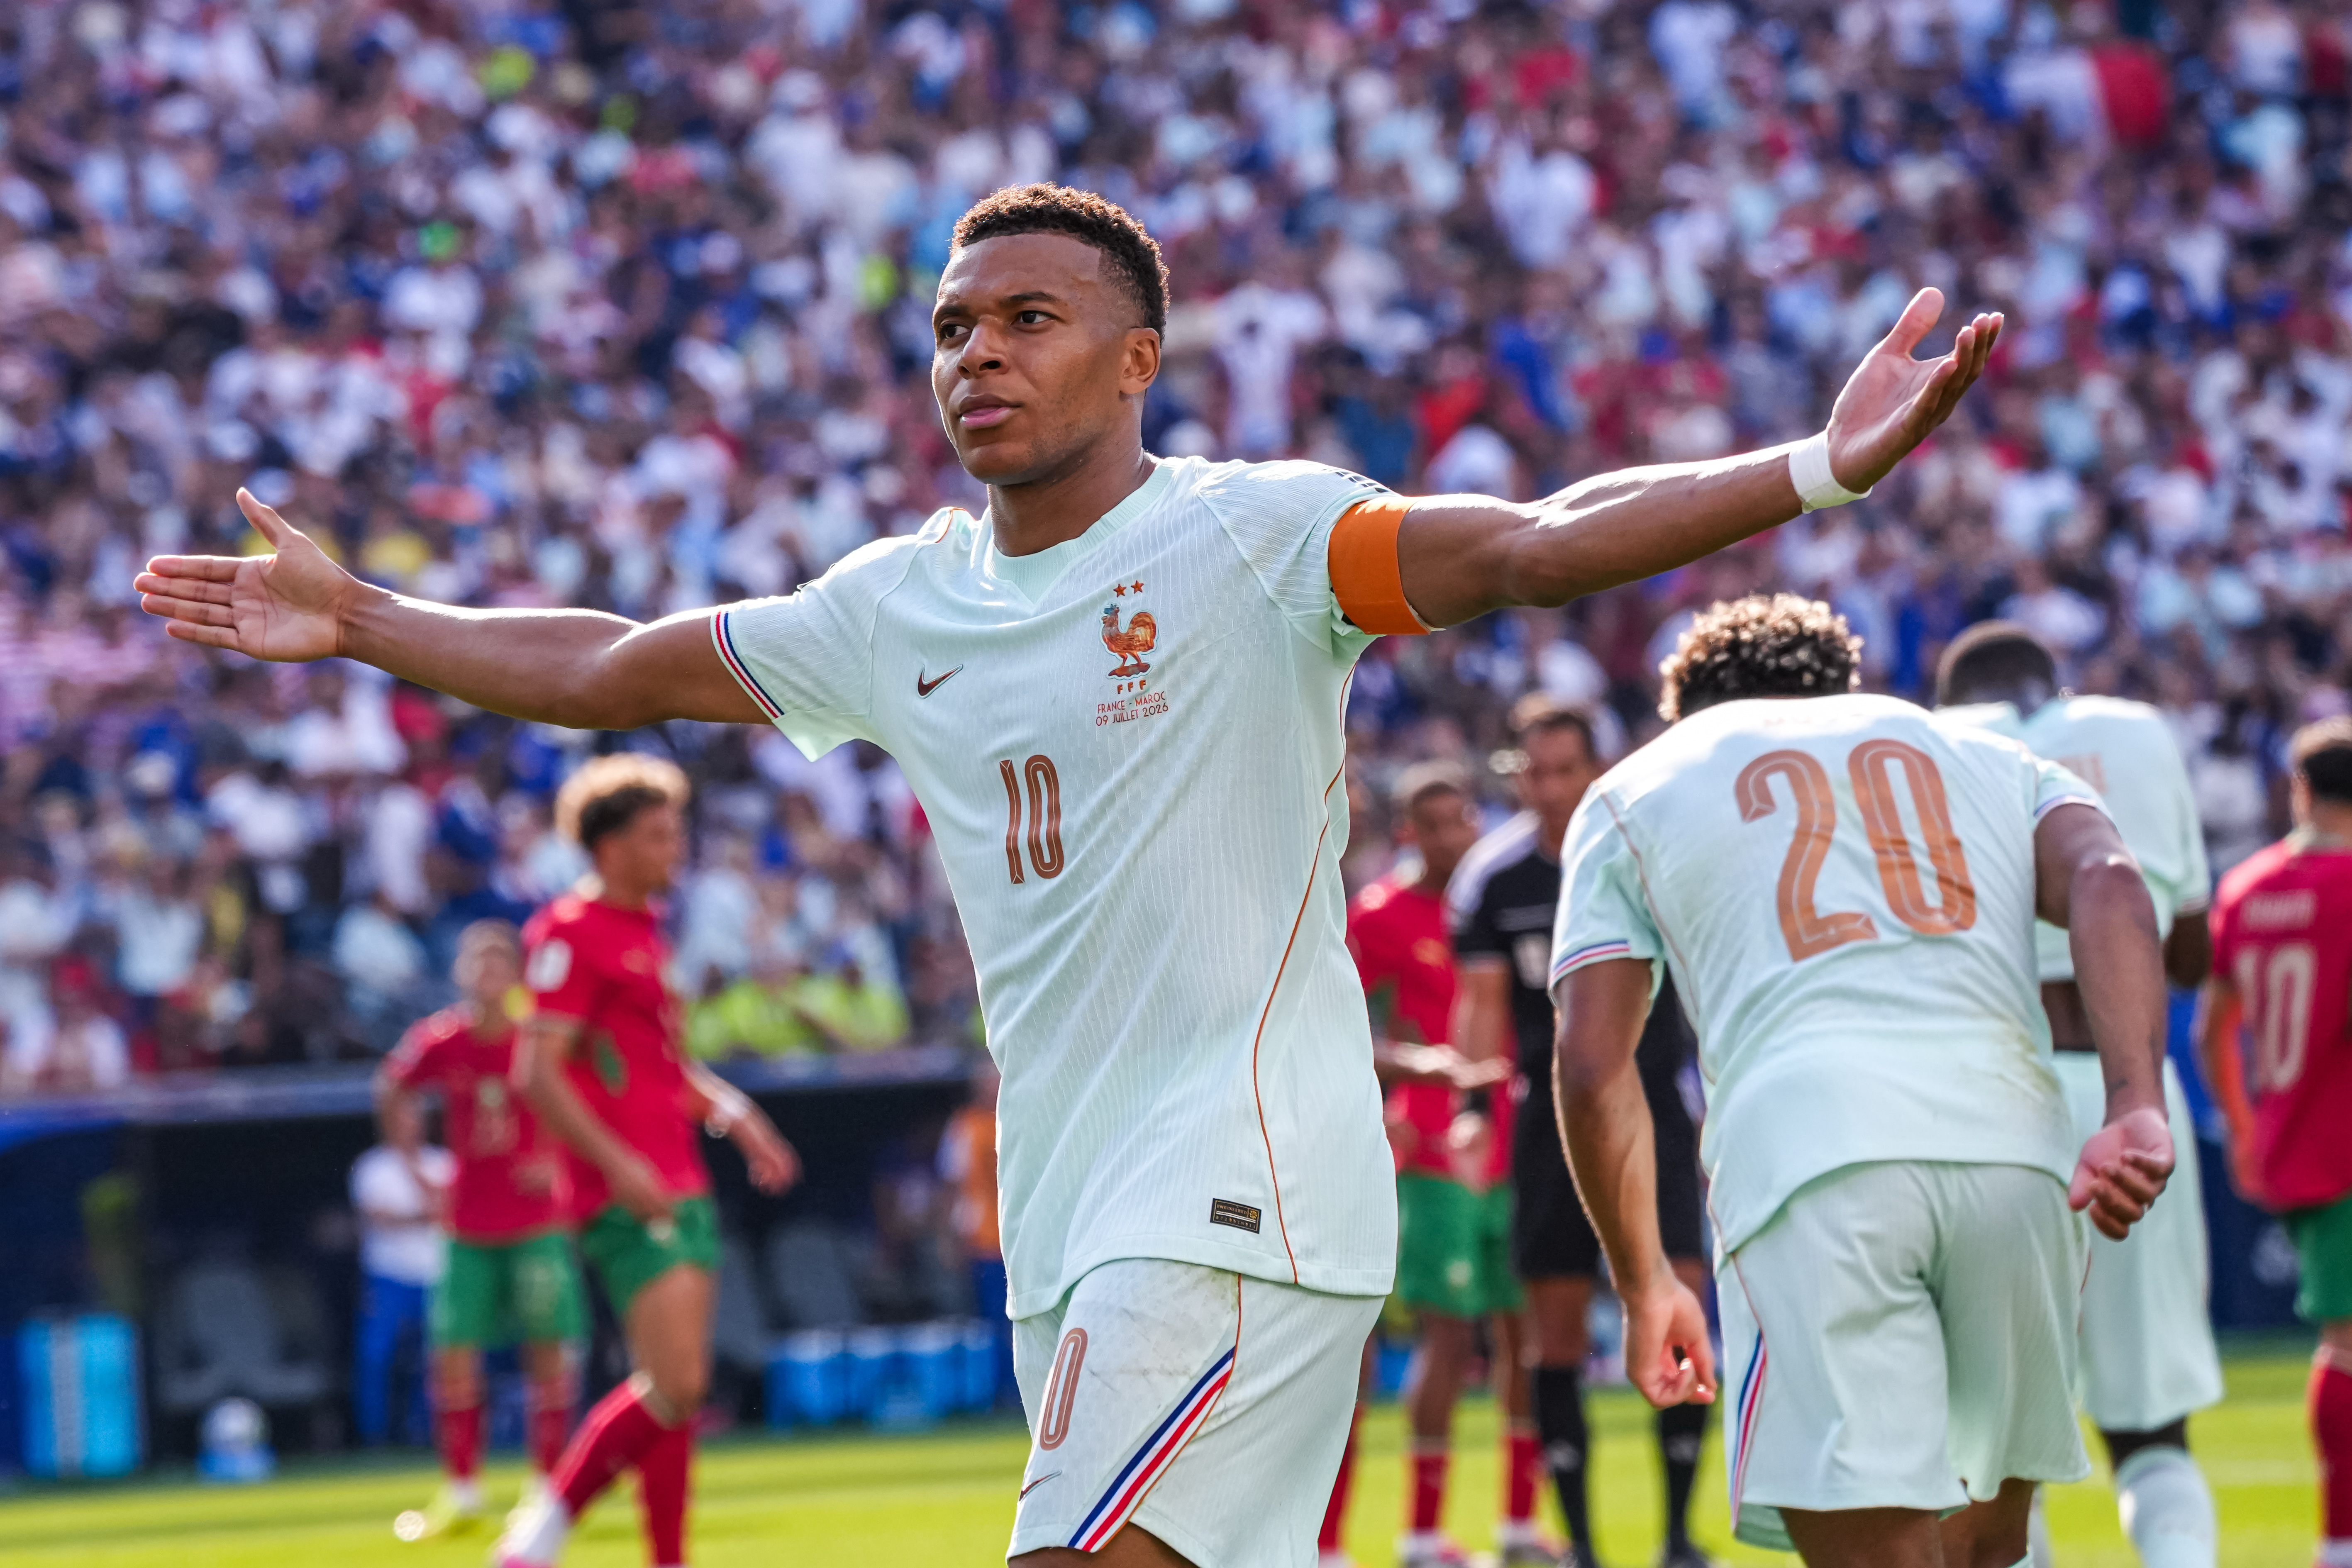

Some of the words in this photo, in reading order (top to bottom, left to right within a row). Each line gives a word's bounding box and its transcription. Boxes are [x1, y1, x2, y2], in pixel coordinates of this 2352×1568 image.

[1096, 715, 1108, 726] 09
[1112, 709, 1139, 724] JUILLET
[1143, 702, 1169, 717] 2026
[1098, 700, 1125, 714] FRANCE
[1135, 691, 1166, 707] MAROC
[1000, 754, 1064, 884] 10
[1734, 739, 1977, 963] 20
